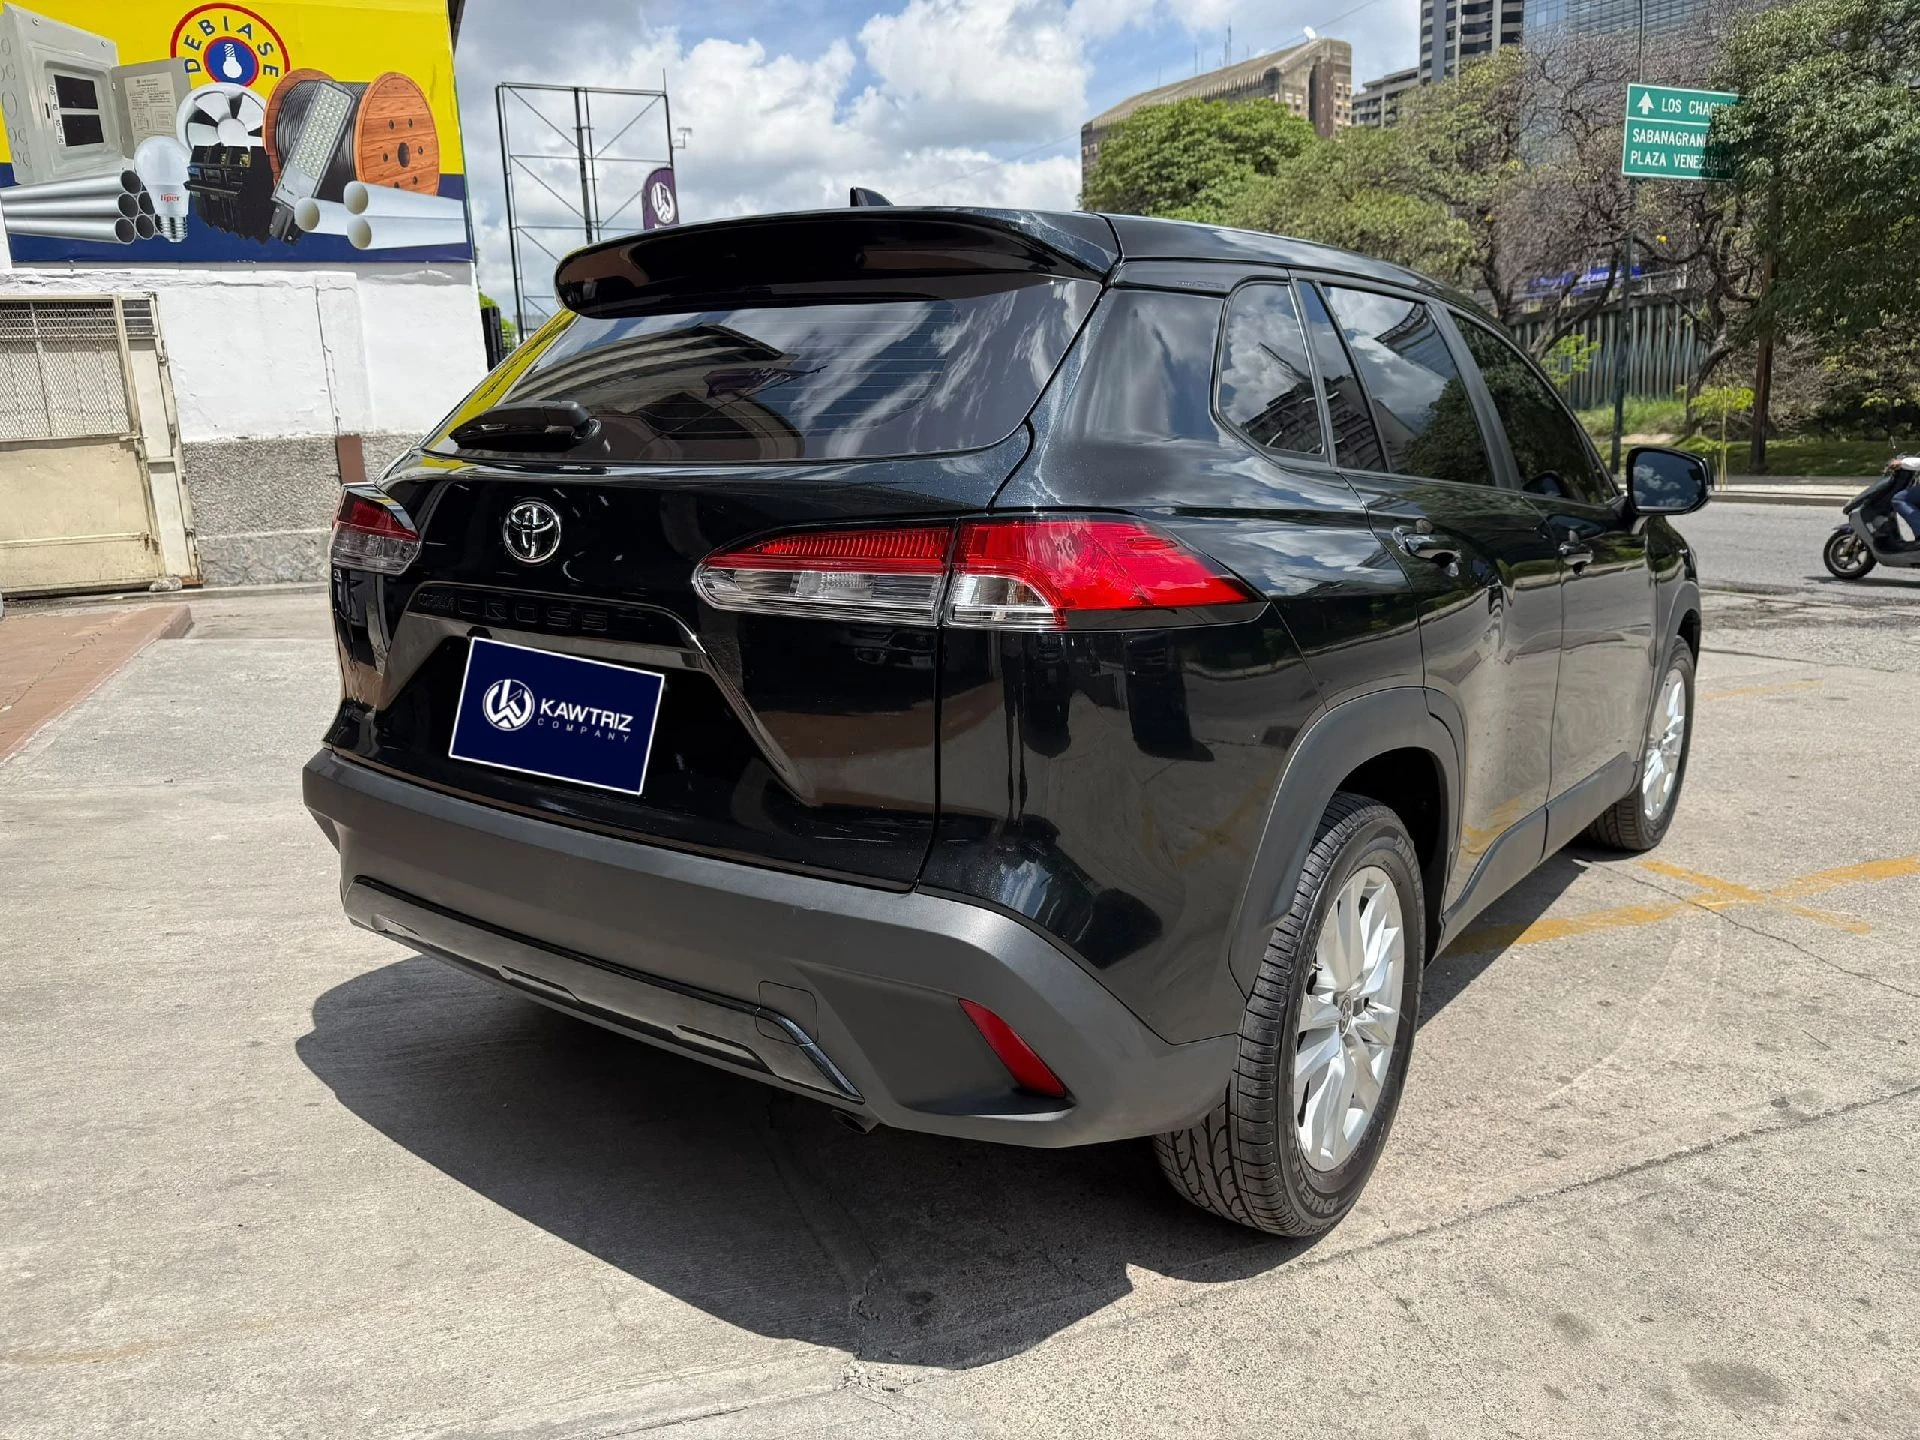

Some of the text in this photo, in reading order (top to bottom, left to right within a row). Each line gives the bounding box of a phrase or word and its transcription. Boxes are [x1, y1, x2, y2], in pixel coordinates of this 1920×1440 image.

[184, 15, 279, 77] DEBIASE
[1661, 97, 1682, 113] LOS
[1630, 150, 1667, 167] PLAZA
[457, 598, 608, 632] CROSS
